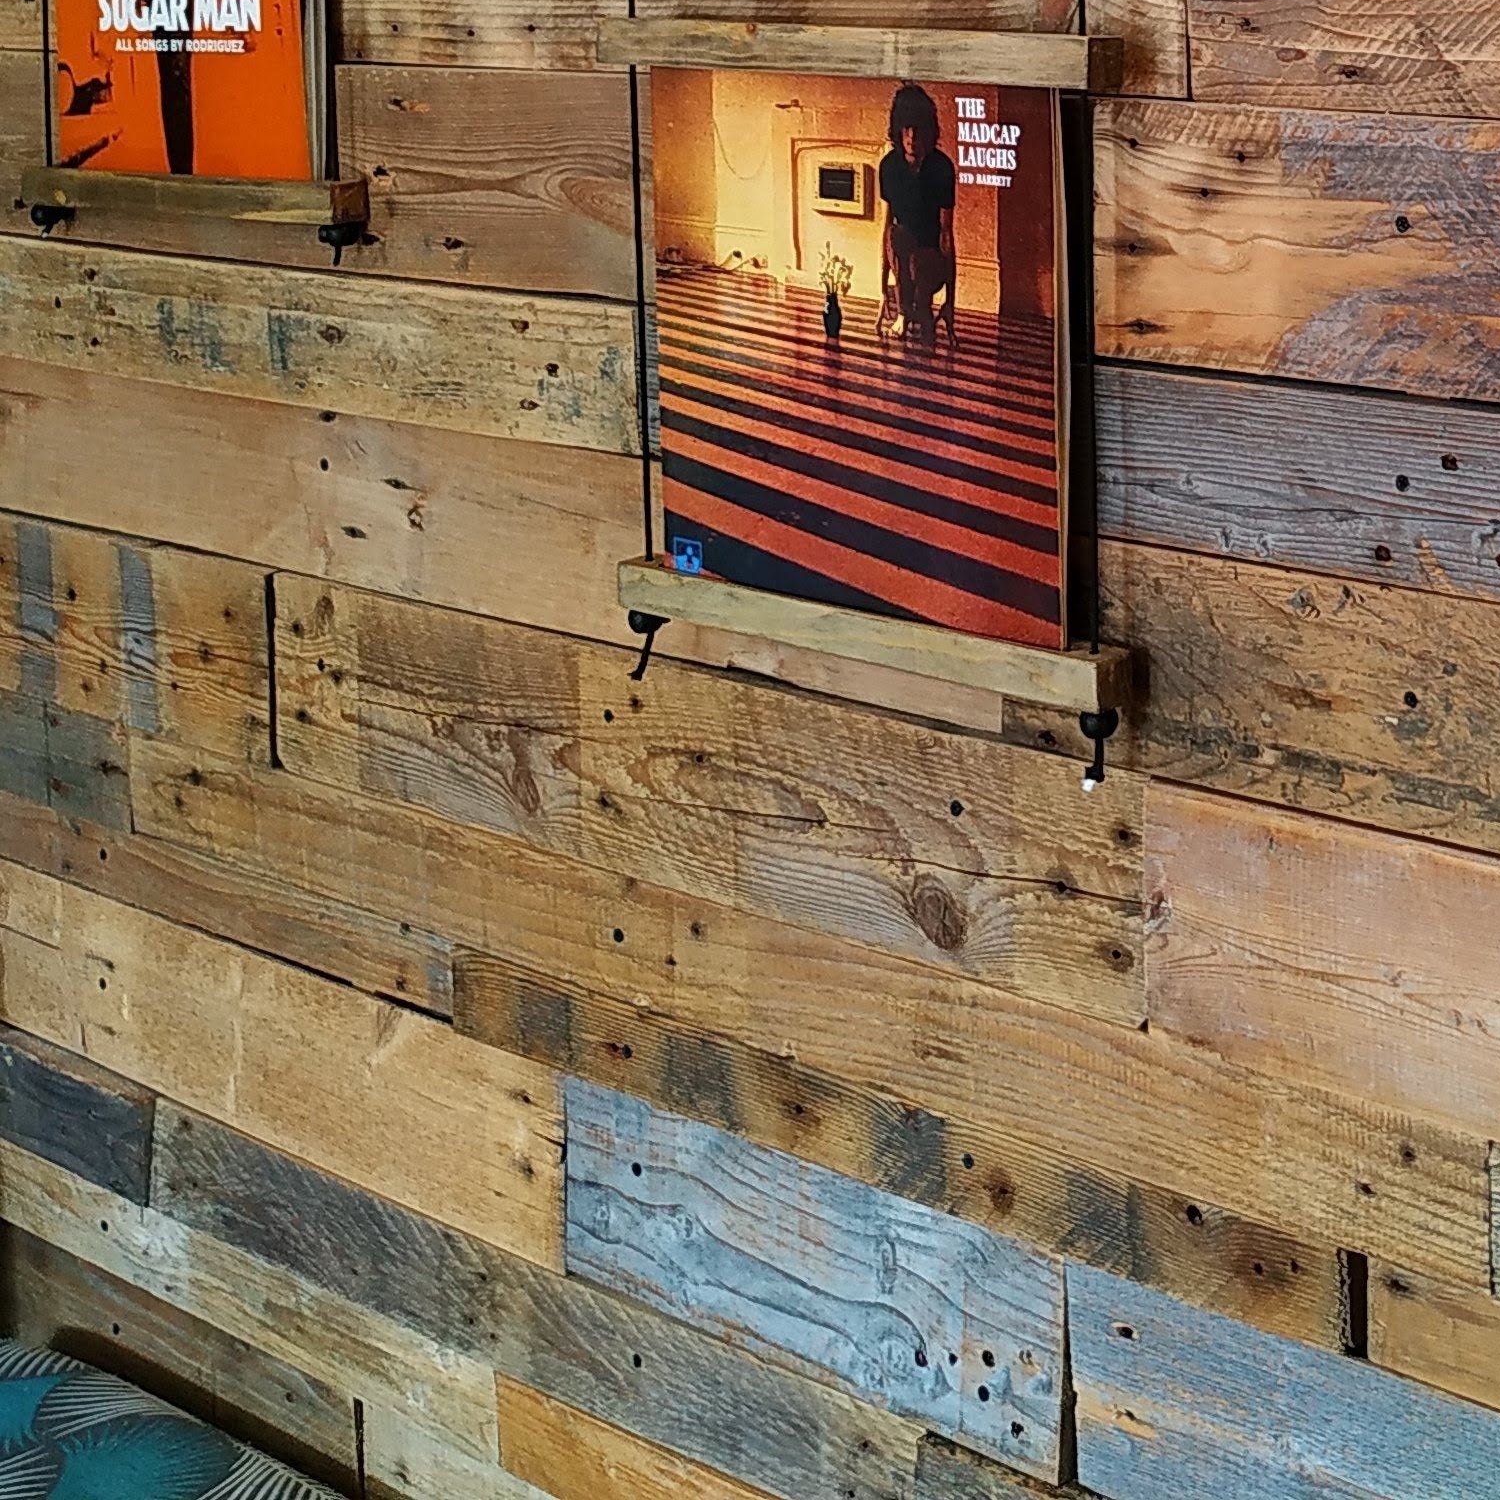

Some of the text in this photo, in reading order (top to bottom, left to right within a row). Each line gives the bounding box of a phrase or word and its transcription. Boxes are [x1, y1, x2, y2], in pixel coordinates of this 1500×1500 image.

[115, 38, 246, 53] ALL SONGS BY RODRIGUEZ
[955, 97, 987, 119] THE
[957, 122, 1021, 146] MADCAP
[957, 146, 1018, 171] LAUGHS
